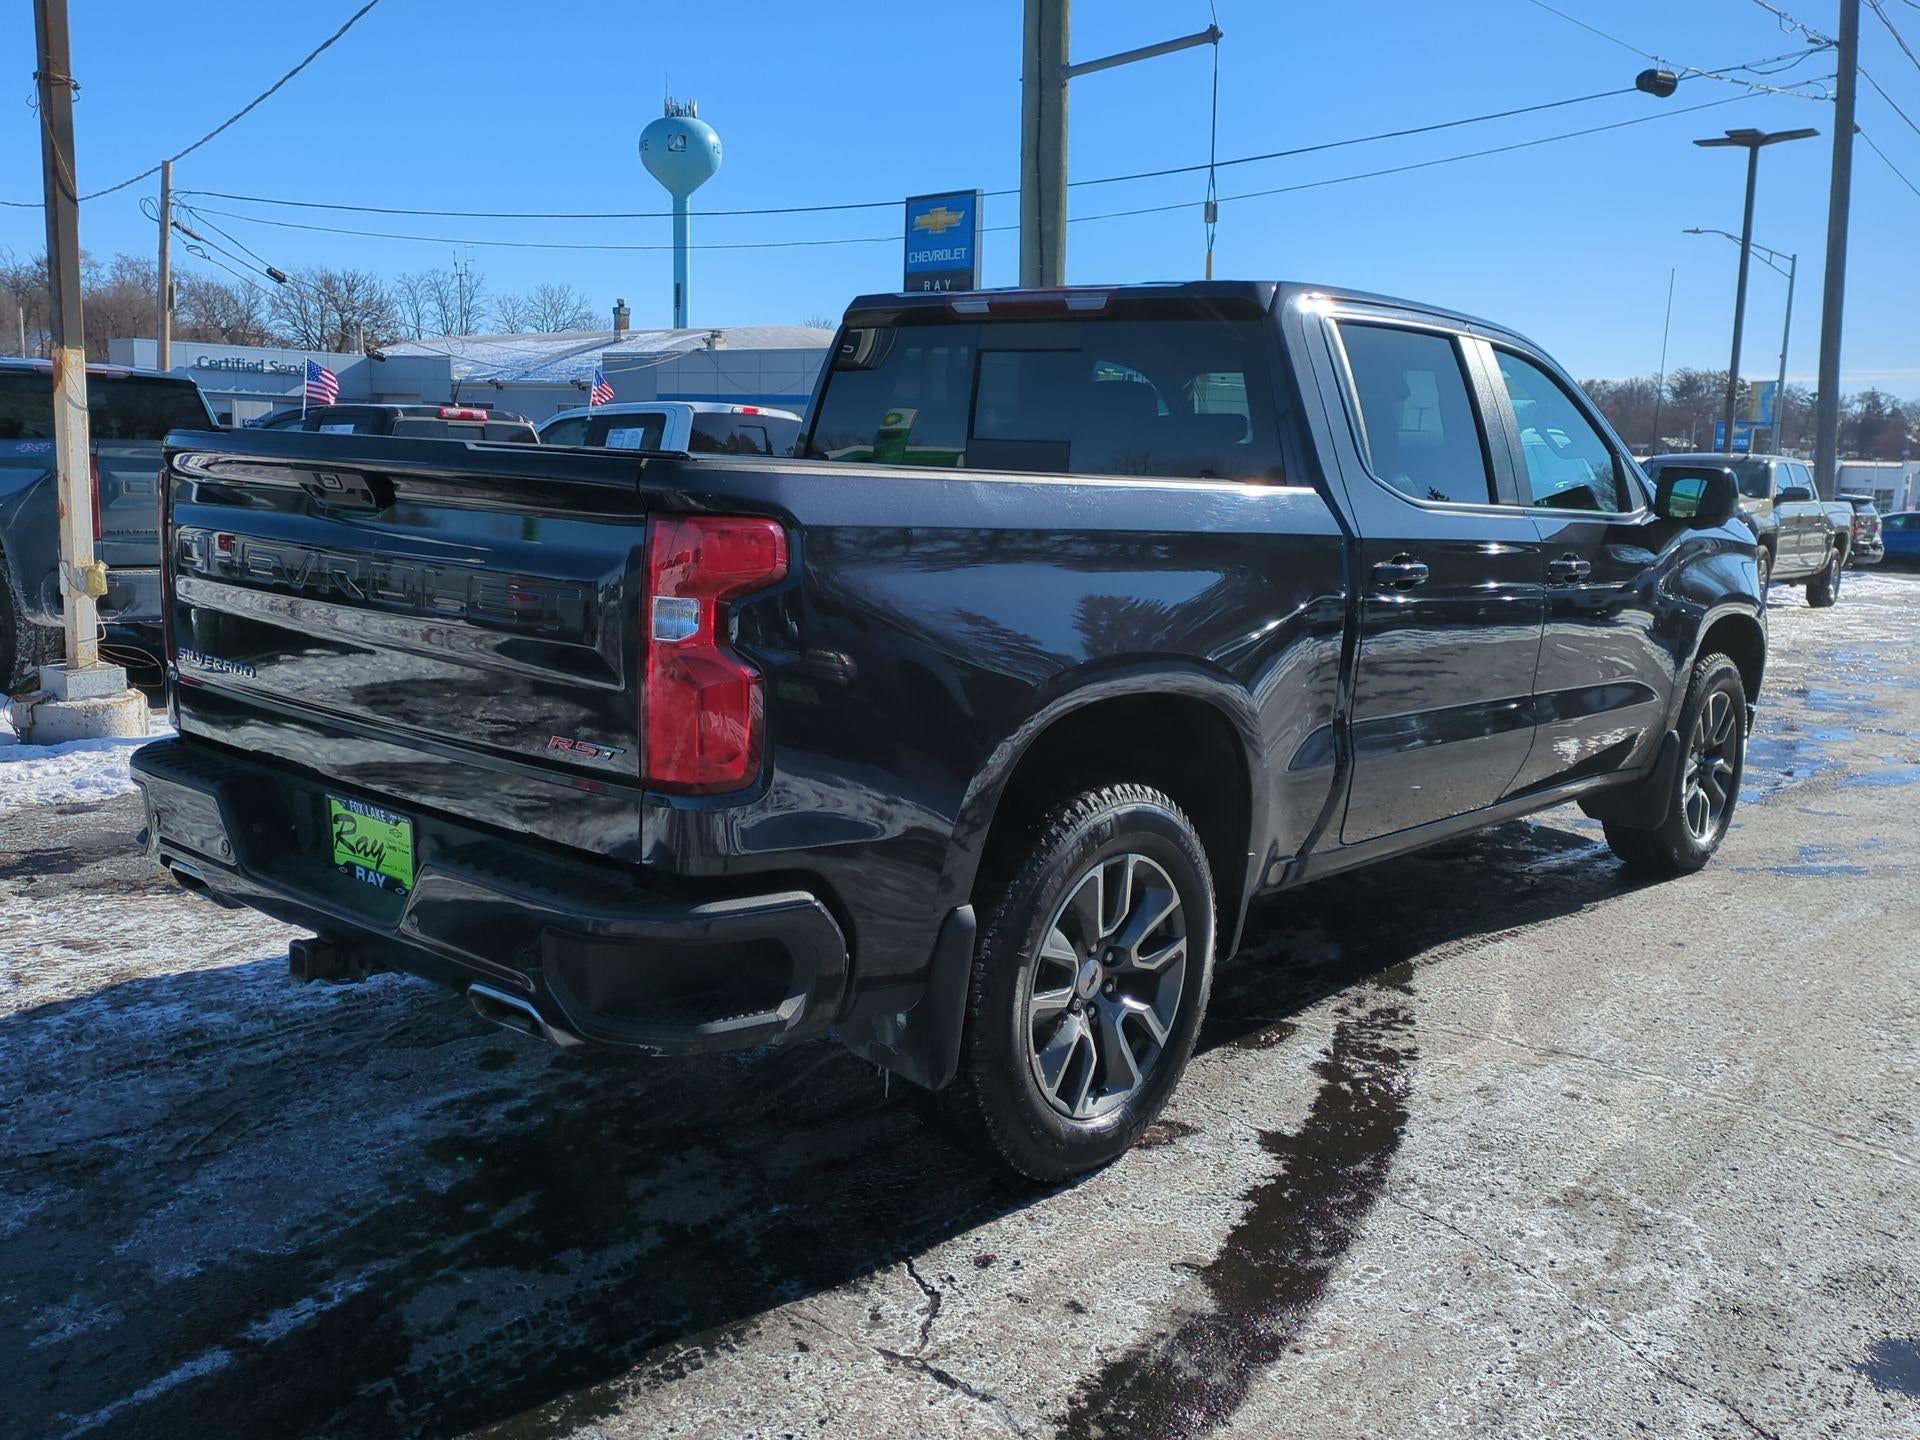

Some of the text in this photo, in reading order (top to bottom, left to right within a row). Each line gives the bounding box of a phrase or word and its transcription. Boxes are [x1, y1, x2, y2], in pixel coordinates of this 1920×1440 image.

[908, 247, 967, 263] CHEVROLET
[924, 279, 951, 292] RAY
[196, 355, 265, 373] Certified
[177, 526, 582, 631] CHEVROLET
[178, 646, 257, 678] SILVERADO
[547, 735, 627, 761] RST
[349, 799, 386, 821] FOX LAKE
[332, 812, 387, 871] Ray
[355, 865, 386, 888] RAY
